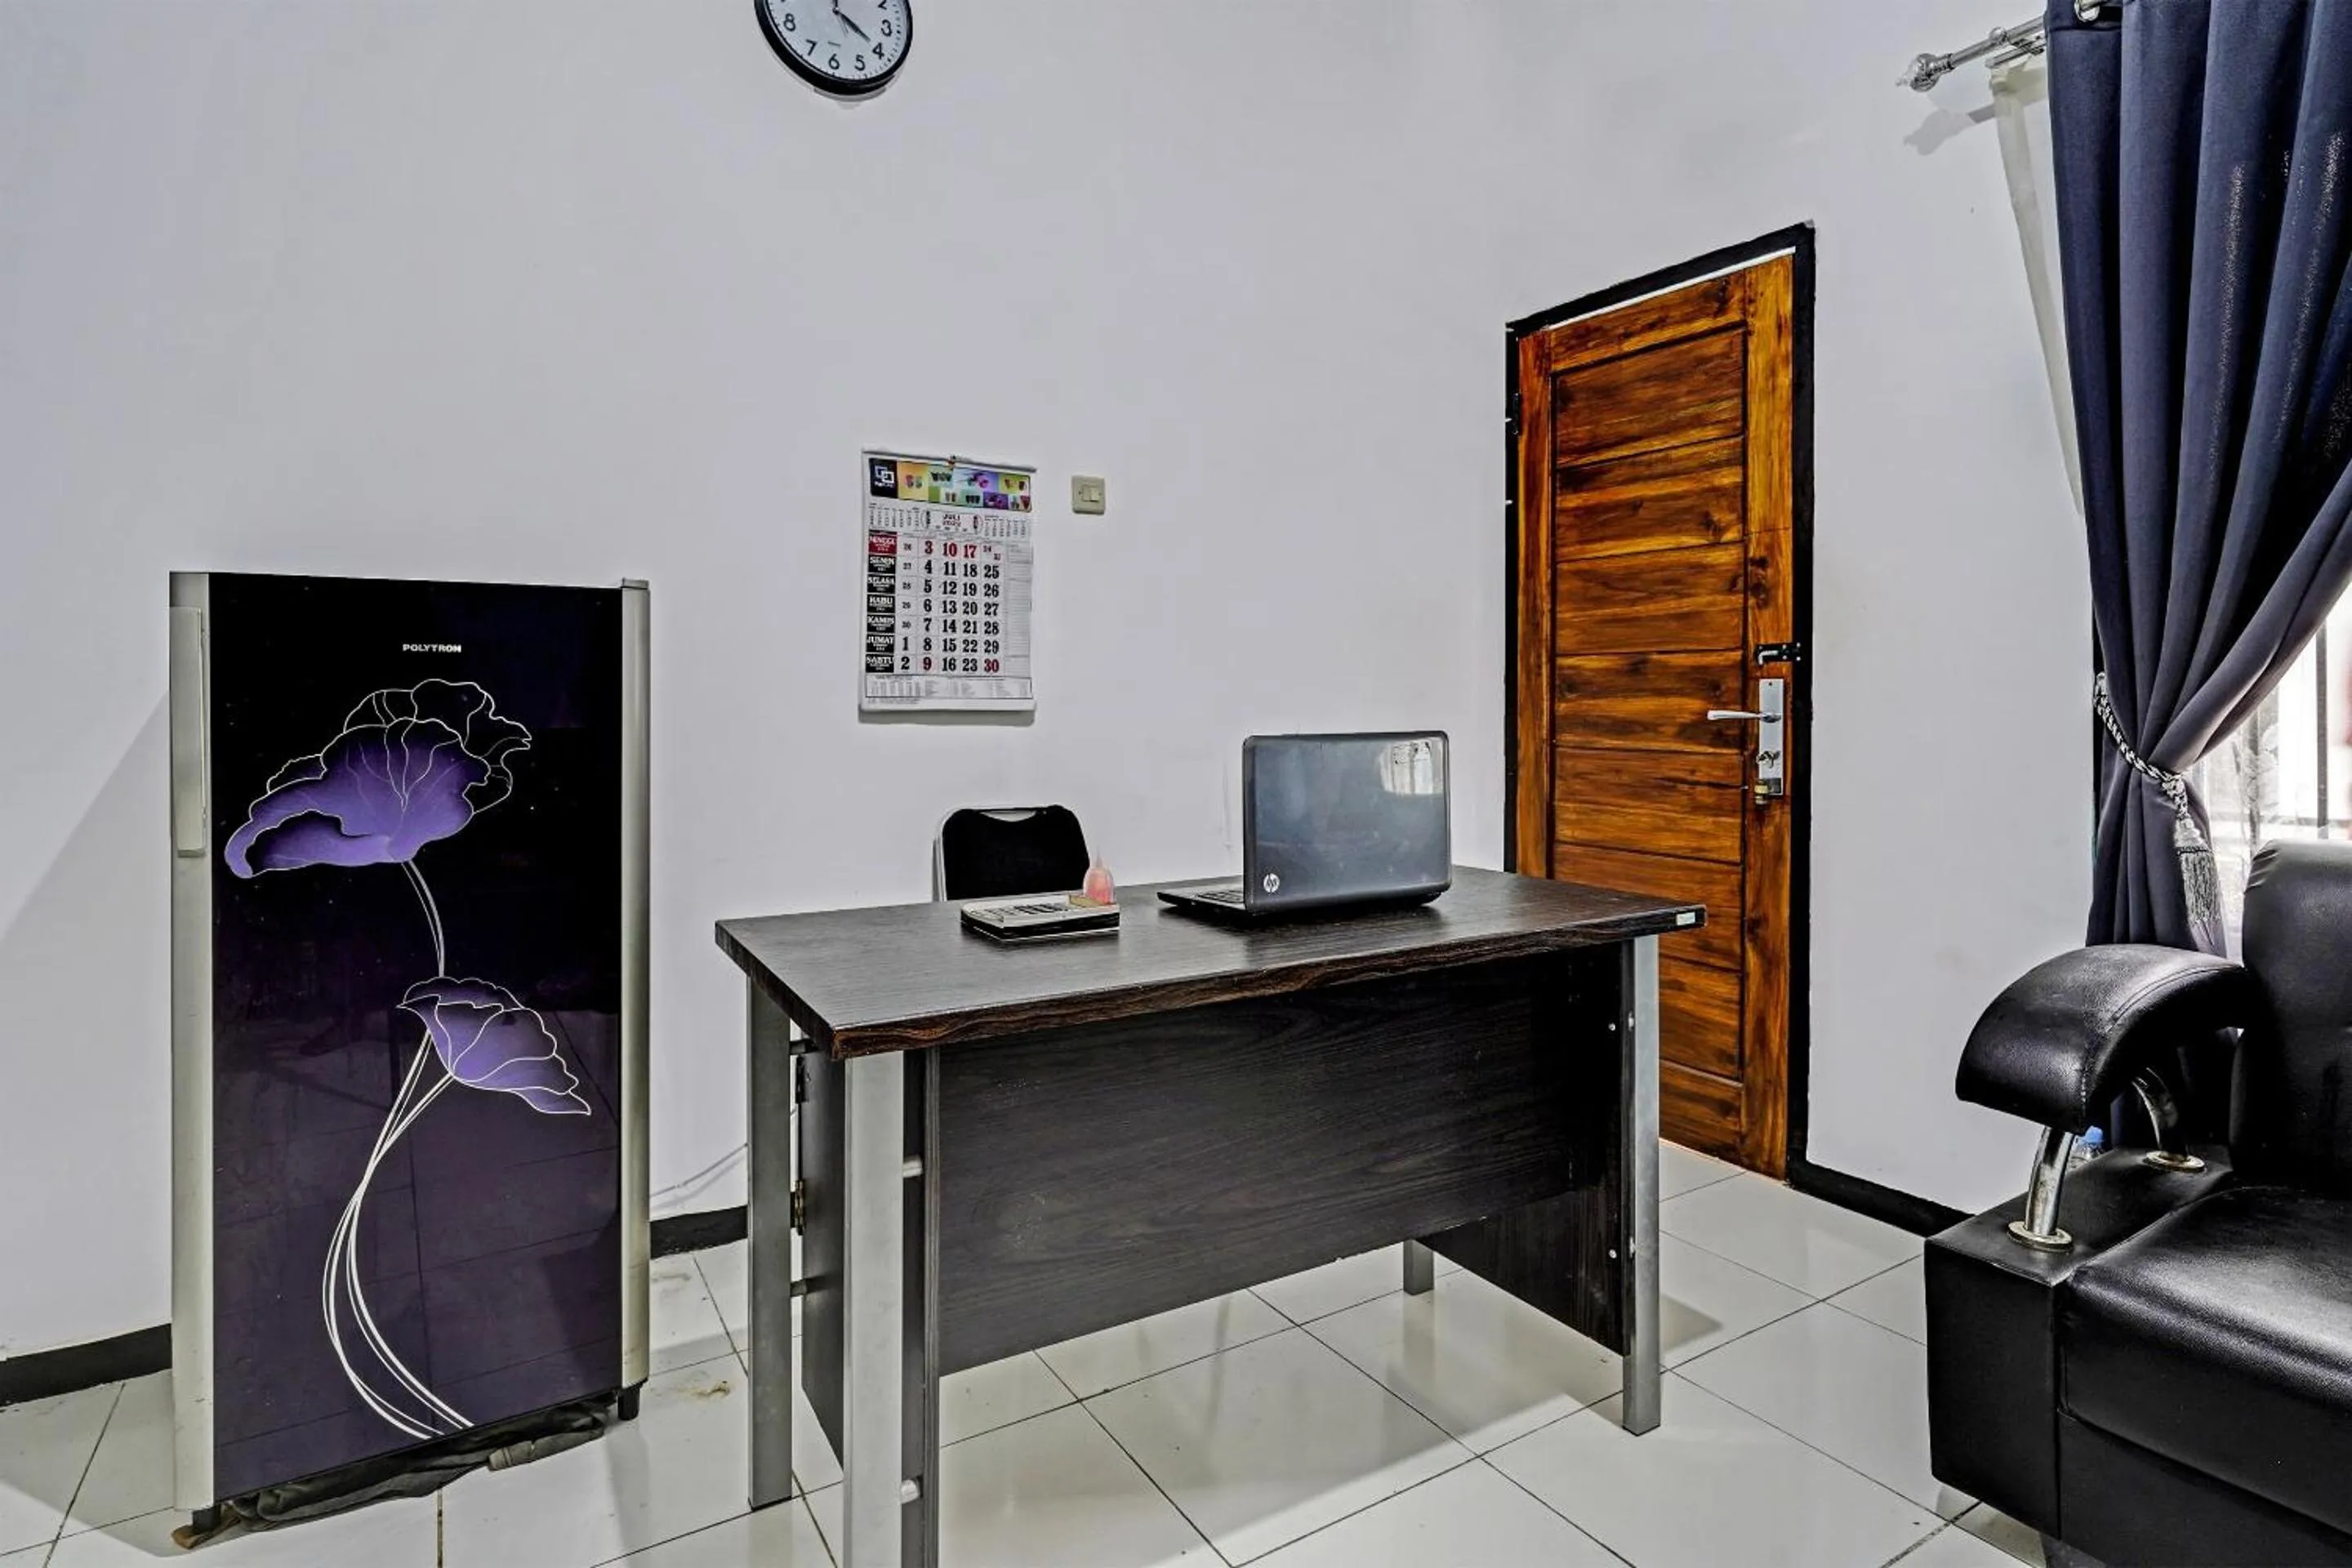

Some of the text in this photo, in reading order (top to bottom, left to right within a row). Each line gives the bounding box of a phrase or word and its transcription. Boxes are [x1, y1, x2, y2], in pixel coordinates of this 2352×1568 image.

[783, 13, 796, 32] 8
[880, 20, 893, 37] 3
[806, 39, 817, 56] 7
[871, 42, 884, 60] 4
[828, 53, 840, 69] 6
[854, 55, 866, 71] 5
[924, 541, 933, 555] 3
[942, 542, 957, 557] 10
[964, 544, 977, 559] 17
[924, 559, 932, 574] 4
[944, 561, 956, 576] 11
[963, 563, 977, 577] 18
[984, 564, 1000, 579] 25
[924, 579, 932, 593] 5
[942, 581, 957, 595] 12
[963, 581, 977, 596] 19
[984, 583, 999, 598] 26
[924, 599, 932, 612] 6
[942, 600, 957, 614] 13
[963, 601, 978, 615] 20
[984, 602, 999, 616] 27
[924, 617, 932, 631] 7
[942, 619, 956, 634] 14
[963, 620, 978, 634] 21
[984, 621, 999, 635] 28
[403, 644, 461, 653] POLYTRON
[866, 636, 893, 644] JUMAT
[902, 636, 908, 651] 1
[924, 637, 932, 651] 8
[942, 638, 956, 653] 15
[962, 639, 978, 653] 22
[984, 639, 999, 654] 29
[901, 657, 910, 670] 2
[923, 657, 932, 670] 9
[942, 657, 956, 671] 16
[962, 658, 978, 671] 23
[984, 658, 999, 673] 30
